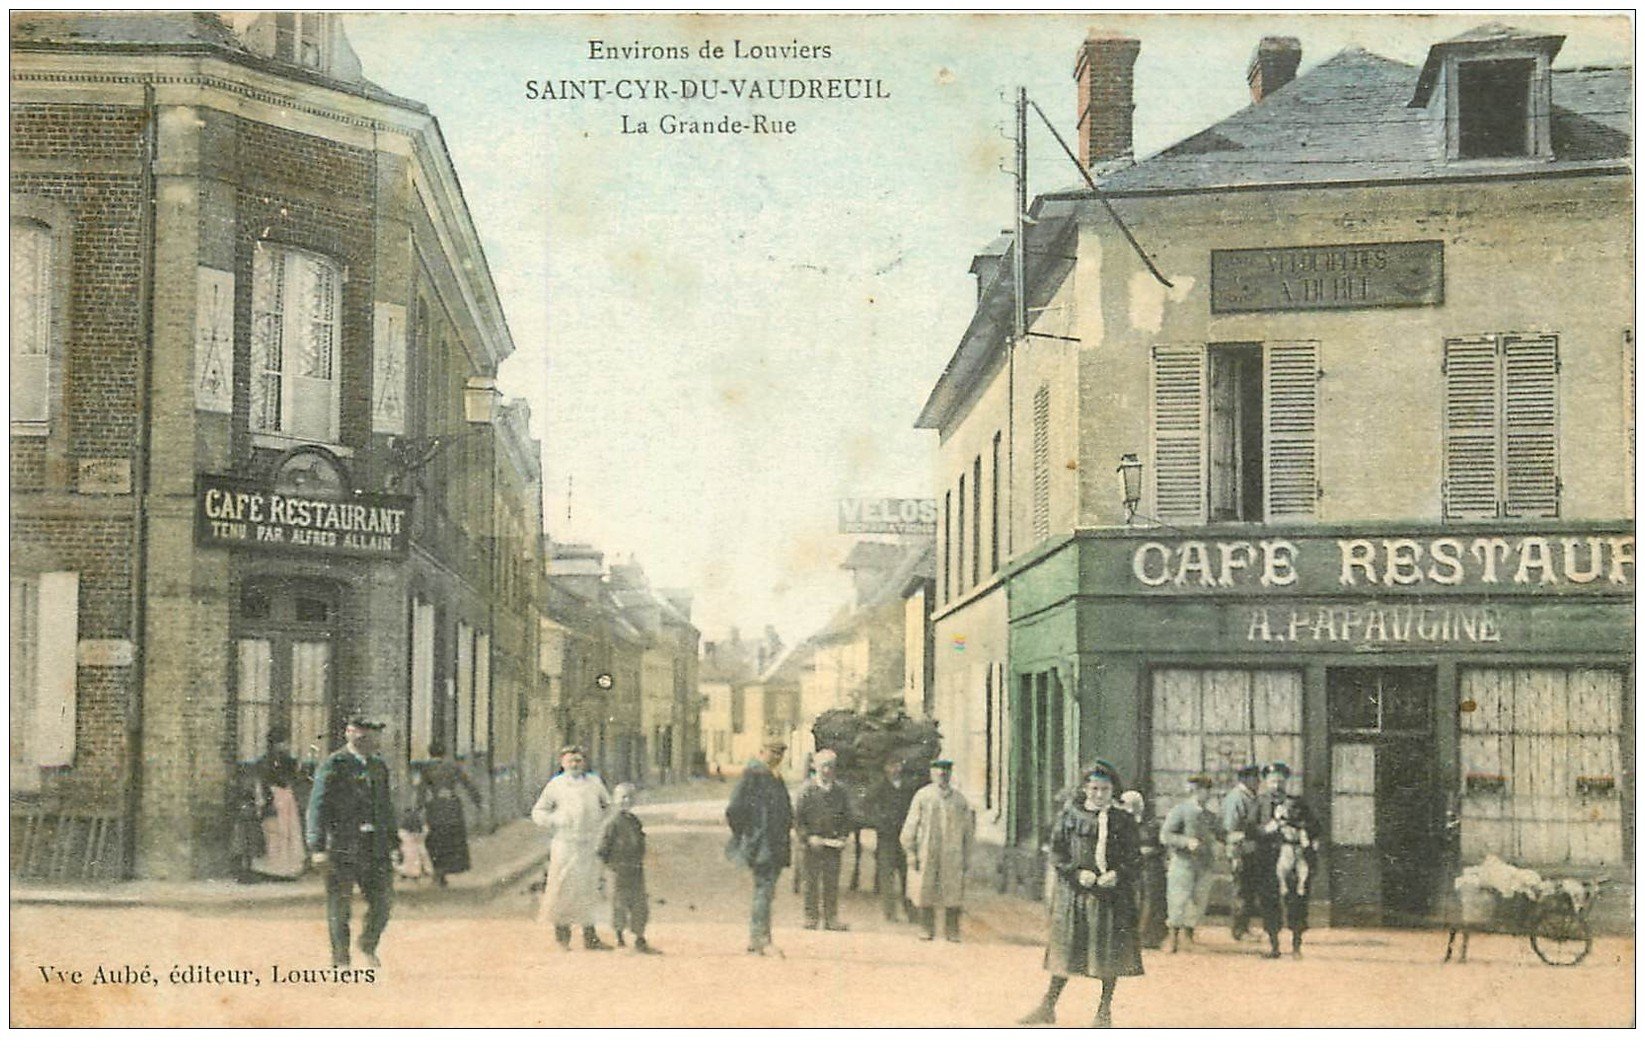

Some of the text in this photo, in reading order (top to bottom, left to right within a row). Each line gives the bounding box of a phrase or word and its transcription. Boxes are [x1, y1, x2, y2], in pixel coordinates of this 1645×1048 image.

[270, 495, 406, 535] RESTAURANT
[211, 521, 392, 551] TENU PAR ALFRED ALLAIN
[1132, 540, 1299, 588] CAFE
